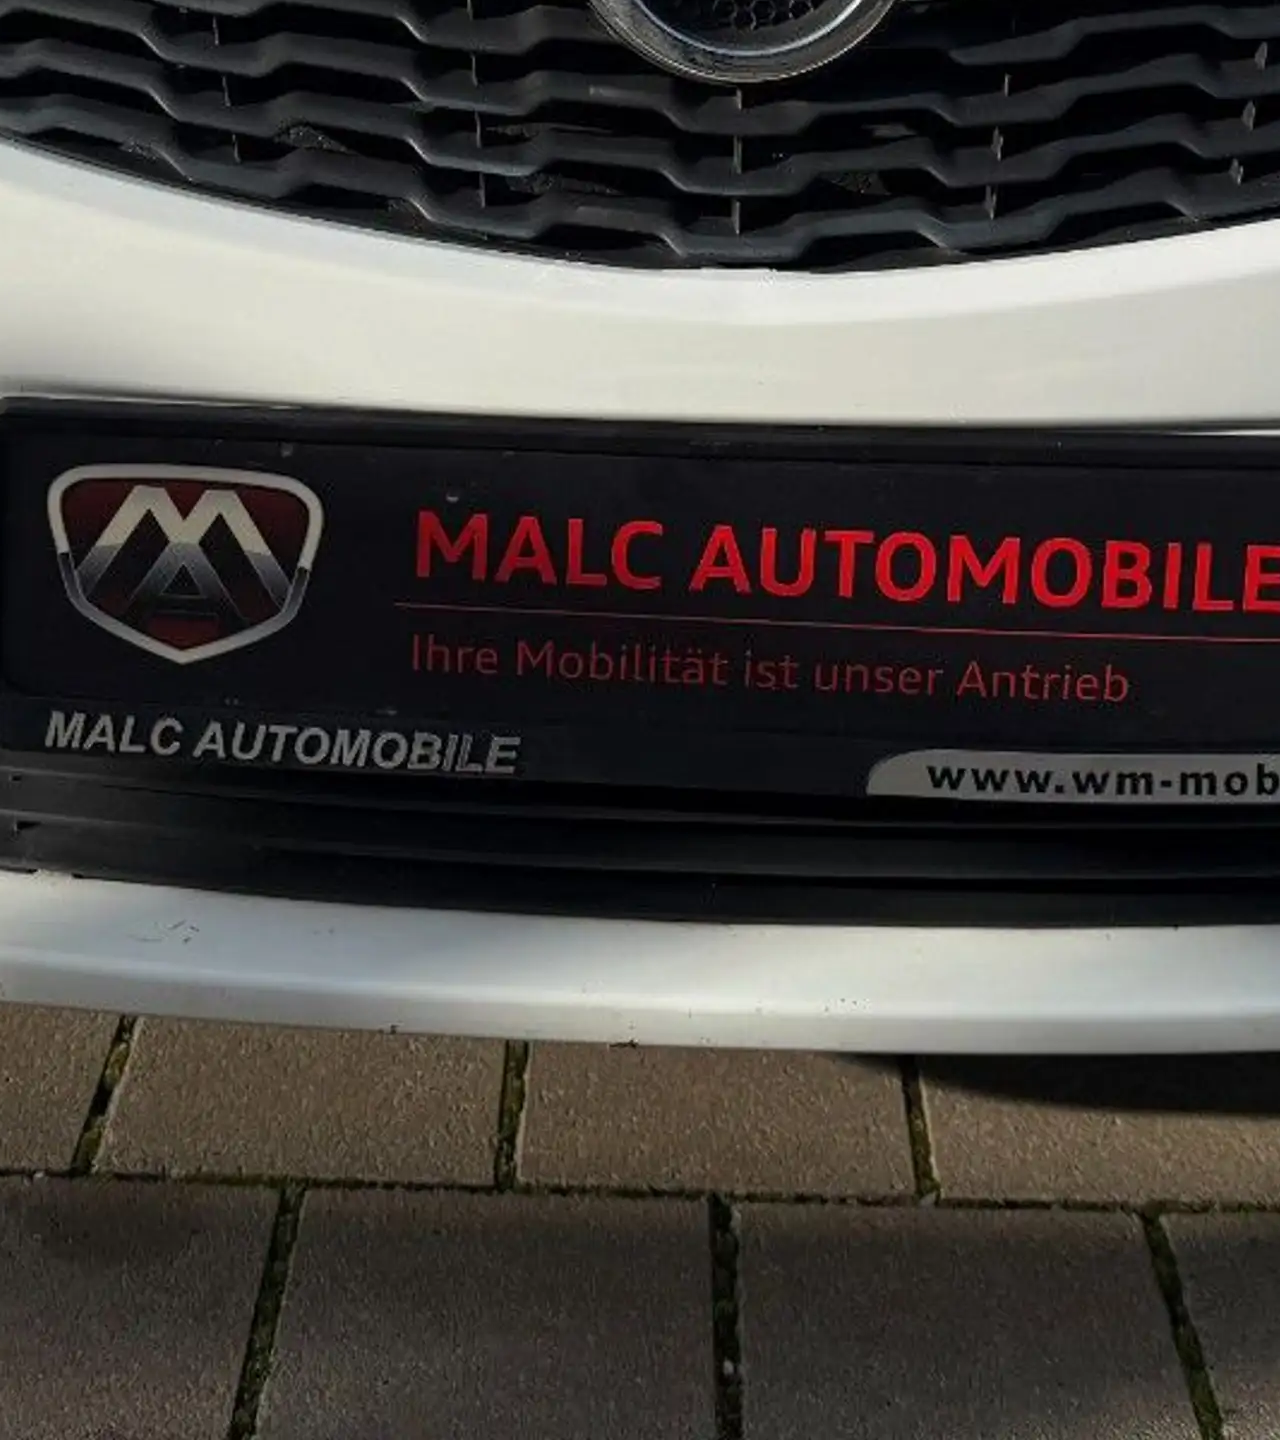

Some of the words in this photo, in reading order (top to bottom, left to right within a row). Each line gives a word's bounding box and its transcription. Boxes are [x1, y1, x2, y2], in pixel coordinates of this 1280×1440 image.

[415, 510, 664, 590] MALC
[411, 633, 499, 675] Ihre
[516, 638, 728, 687] Mobilität
[743, 649, 800, 690] ist
[814, 662, 944, 696] unser
[955, 659, 1130, 703] Antrieb
[44, 709, 184, 756] MALC
[192, 720, 522, 775] AUTOMOBILE
